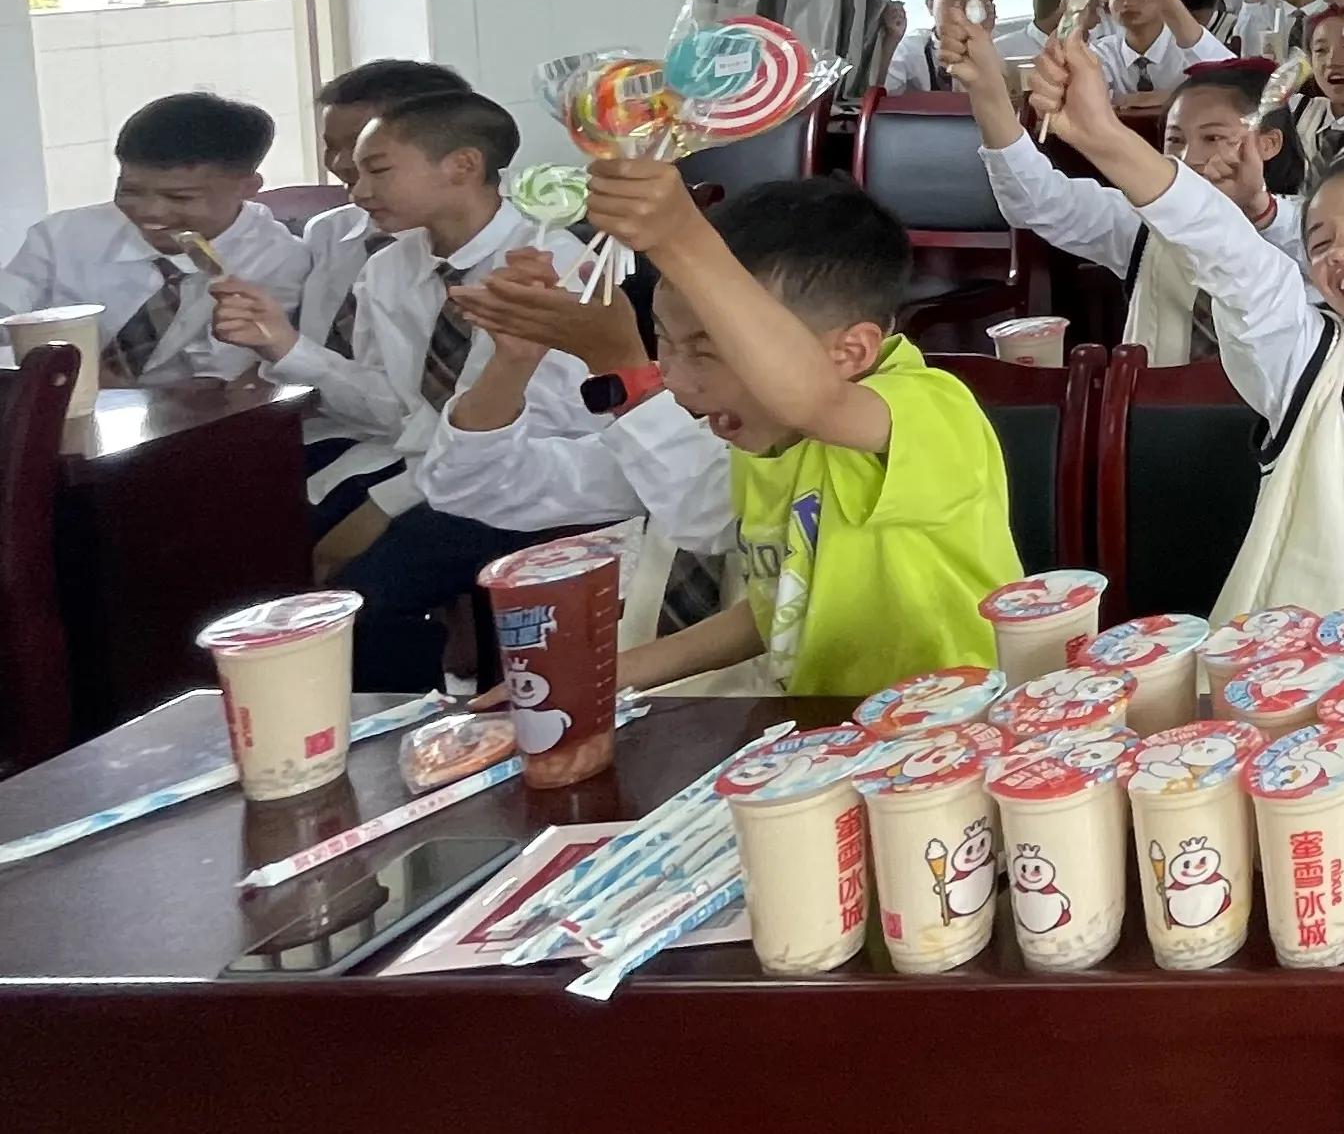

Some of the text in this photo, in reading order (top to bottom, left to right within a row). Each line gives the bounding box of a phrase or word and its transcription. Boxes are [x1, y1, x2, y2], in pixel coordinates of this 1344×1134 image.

[1289, 830, 1329, 949] 蜜雪冰城
[1330, 858, 1344, 906] mixue
